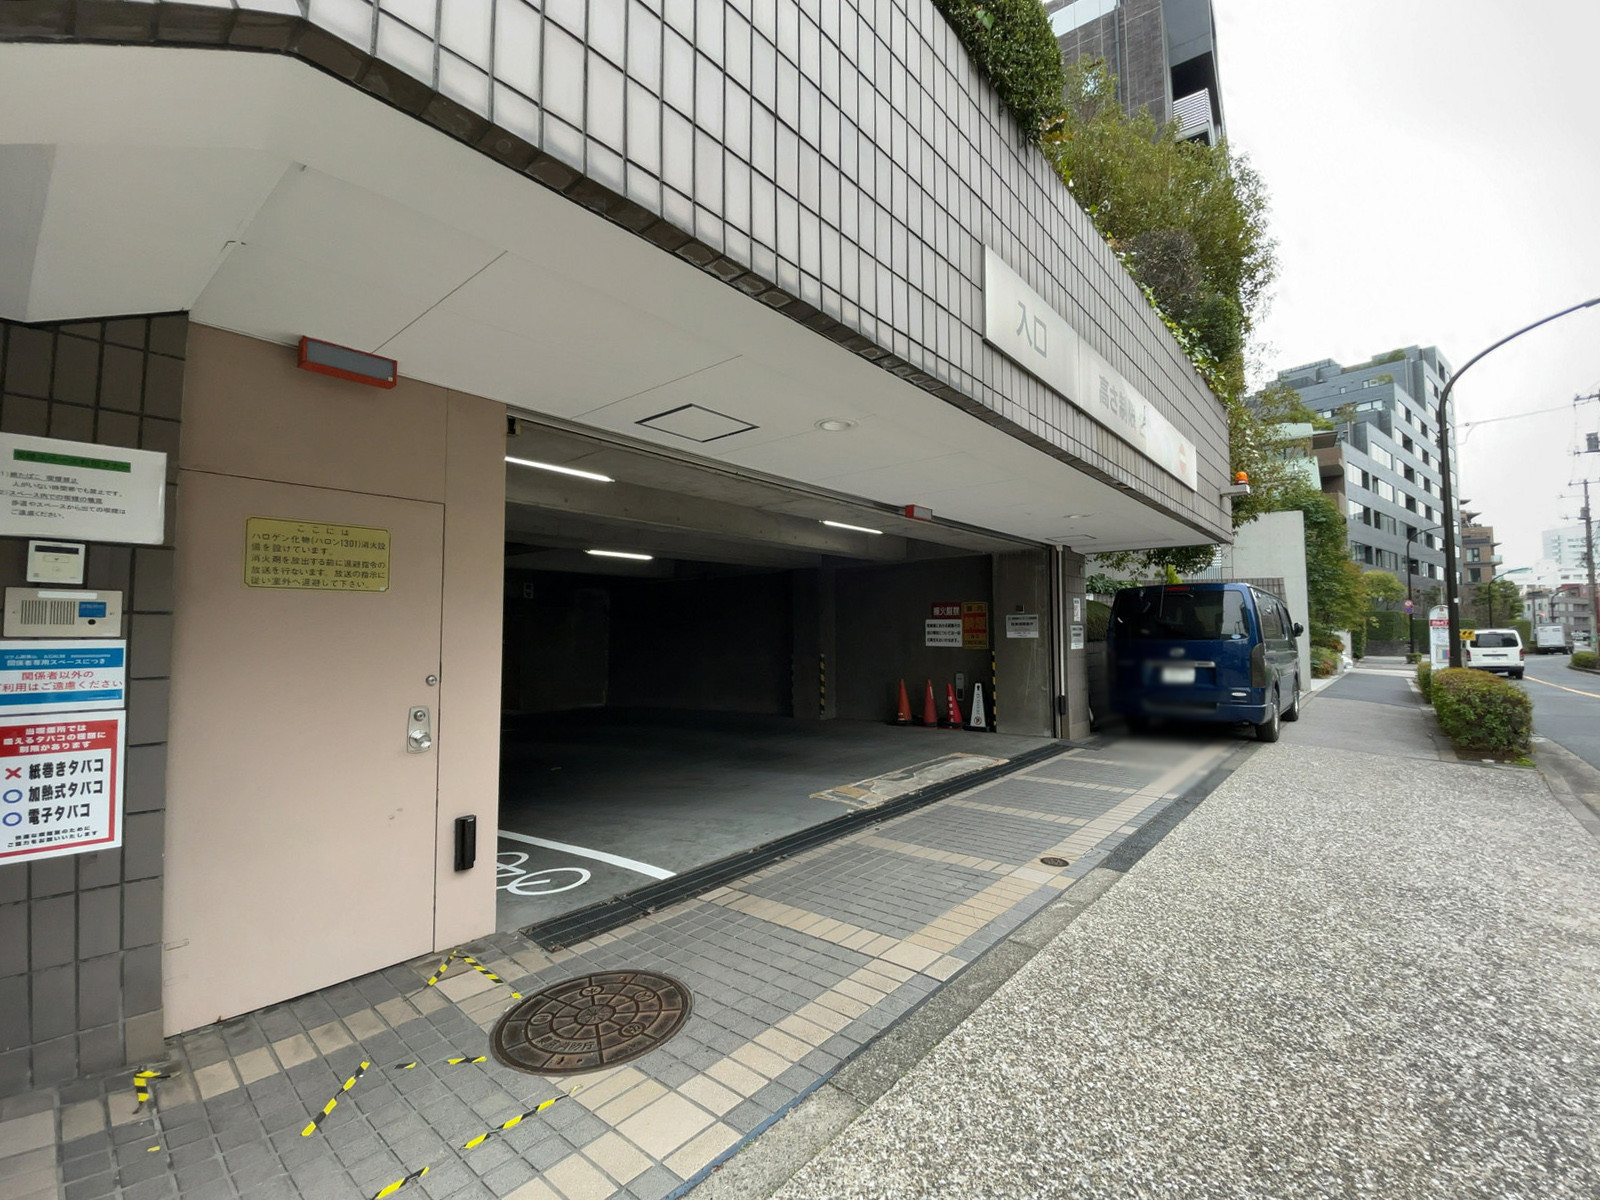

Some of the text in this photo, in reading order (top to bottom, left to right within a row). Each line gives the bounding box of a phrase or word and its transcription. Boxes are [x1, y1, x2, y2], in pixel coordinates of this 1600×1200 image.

[1015, 300, 1047, 359] 入口
[21, 670, 94, 681] 関係者以外の
[19, 740, 92, 754] 制限があります
[28, 758, 104, 780] 紙巻きタバコ
[28, 779, 104, 803] 加熱式タバコ
[28, 802, 91, 826] 電子タバコ
